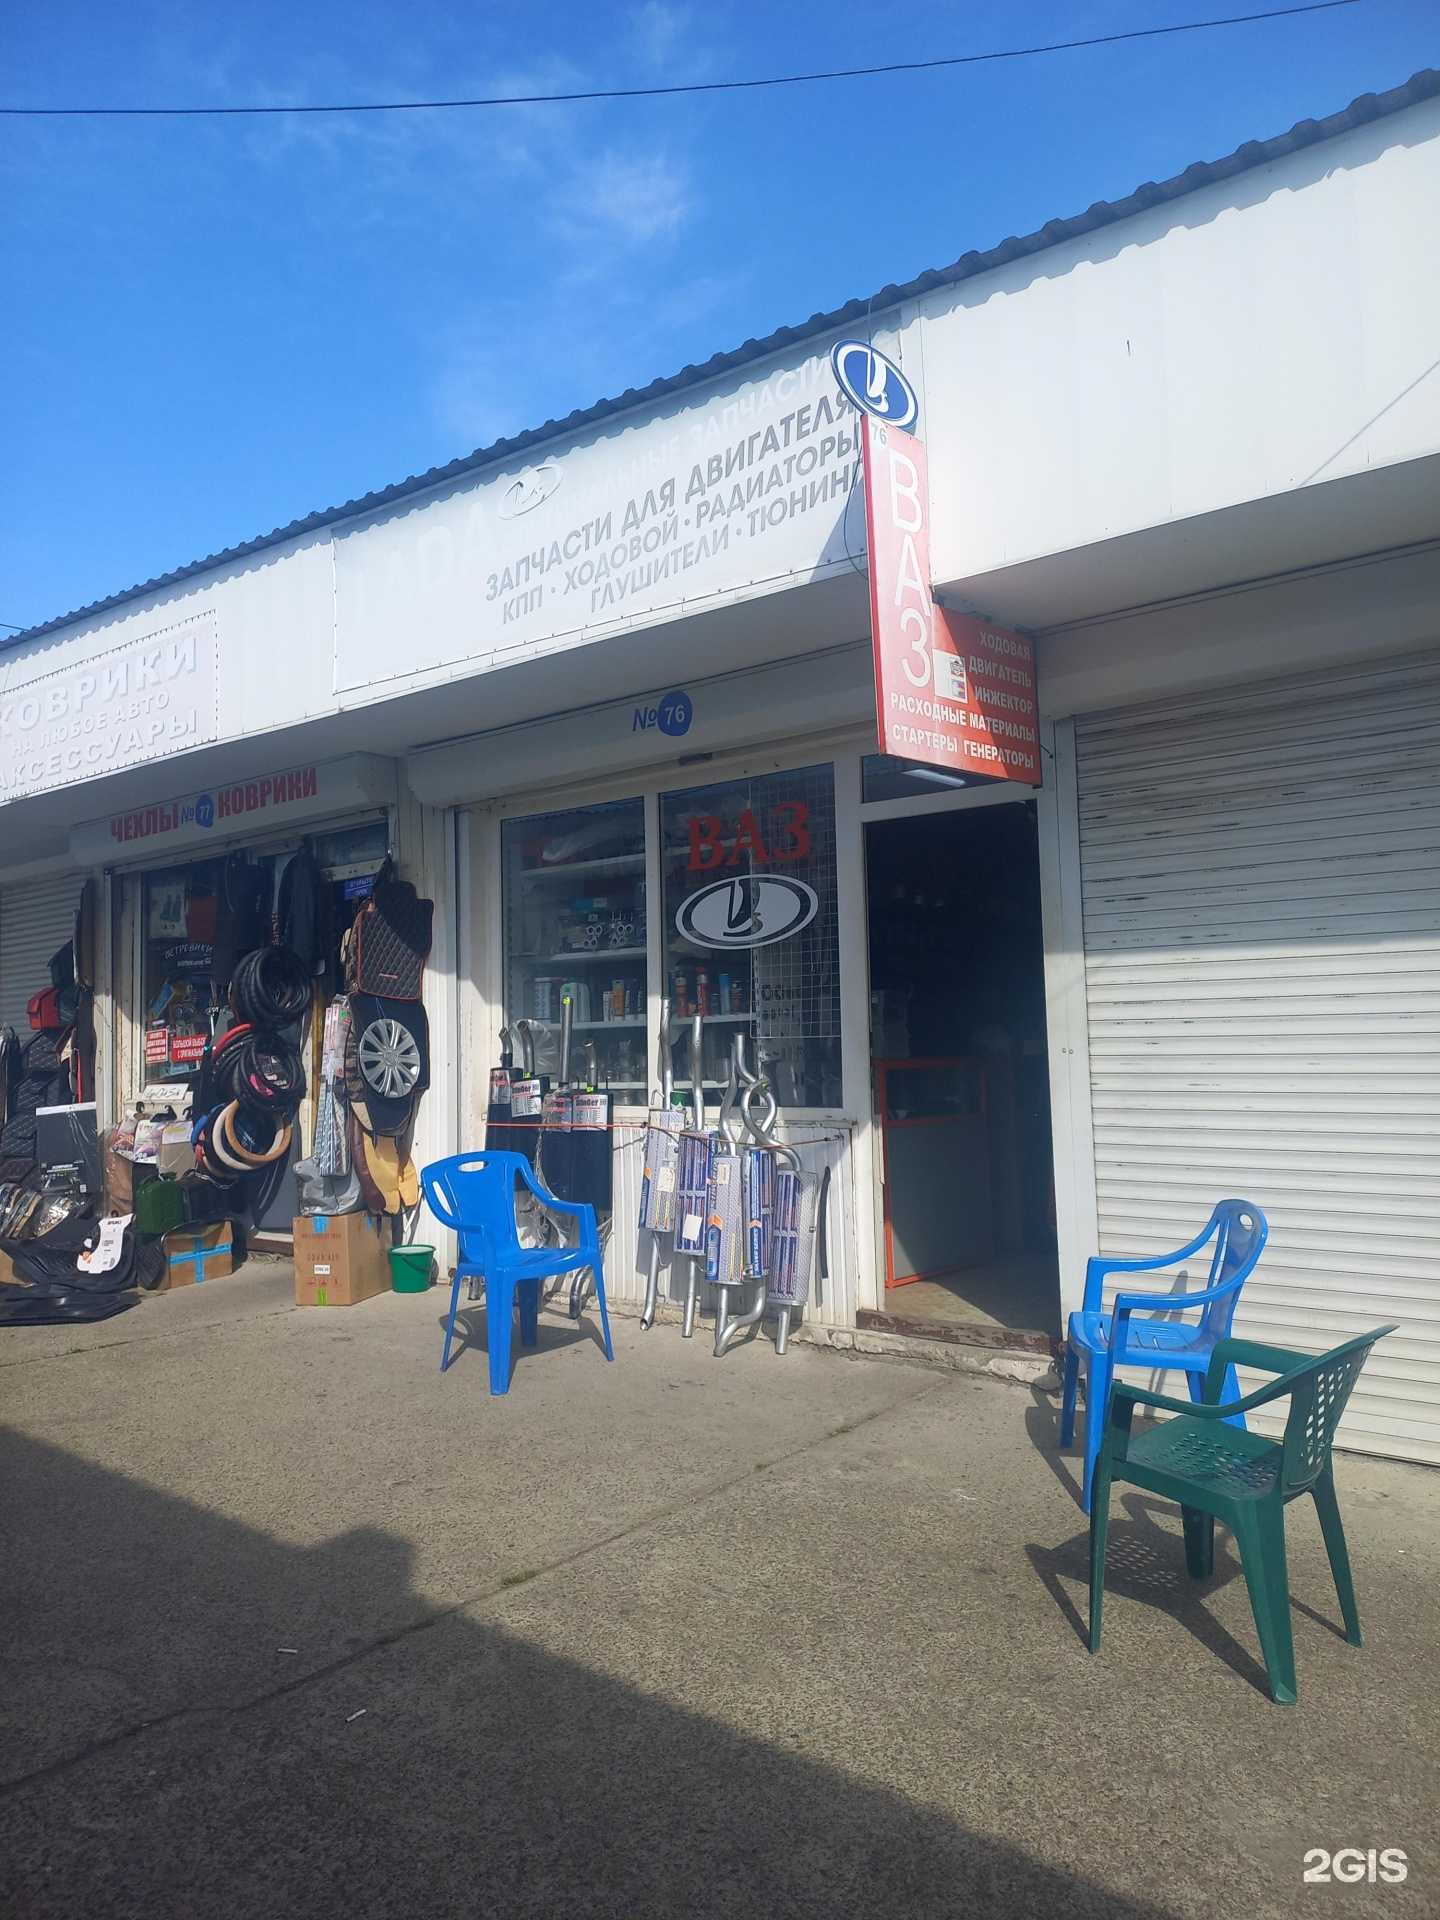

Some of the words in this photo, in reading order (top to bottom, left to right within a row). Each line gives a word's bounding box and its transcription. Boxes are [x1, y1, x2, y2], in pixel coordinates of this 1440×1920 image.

[871, 422, 888, 447] 76
[486, 511, 612, 601] ЗАПЧАСТИ
[620, 476, 676, 537] ДЛЯ
[685, 389, 855, 505] ДВИГАТЕЛЯ
[503, 584, 543, 625] КПП
[563, 510, 679, 595] ХОДОВОЙ
[696, 423, 859, 529] РАДИАТОРЫ
[591, 523, 729, 613] ГЛУШИТЕЛИ
[889, 447, 932, 688] ВАЗ
[968, 655, 1032, 688] ДВИГАТЕЛЬ
[980, 631, 1031, 661] ХОДОВАЯ
[890, 692, 967, 725] РАСХОДНЫЕ
[969, 712, 1035, 744] МАТЕРИАЛЫ
[974, 685, 1033, 714] ИНЖЕКТОР
[892, 724, 958, 753] СТАРТЕРЫ
[963, 739, 1034, 768] ГЕНЕРАТОРЫ
[217, 767, 317, 818] КОВРИКИ
[687, 801, 813, 872] ВАЗ
